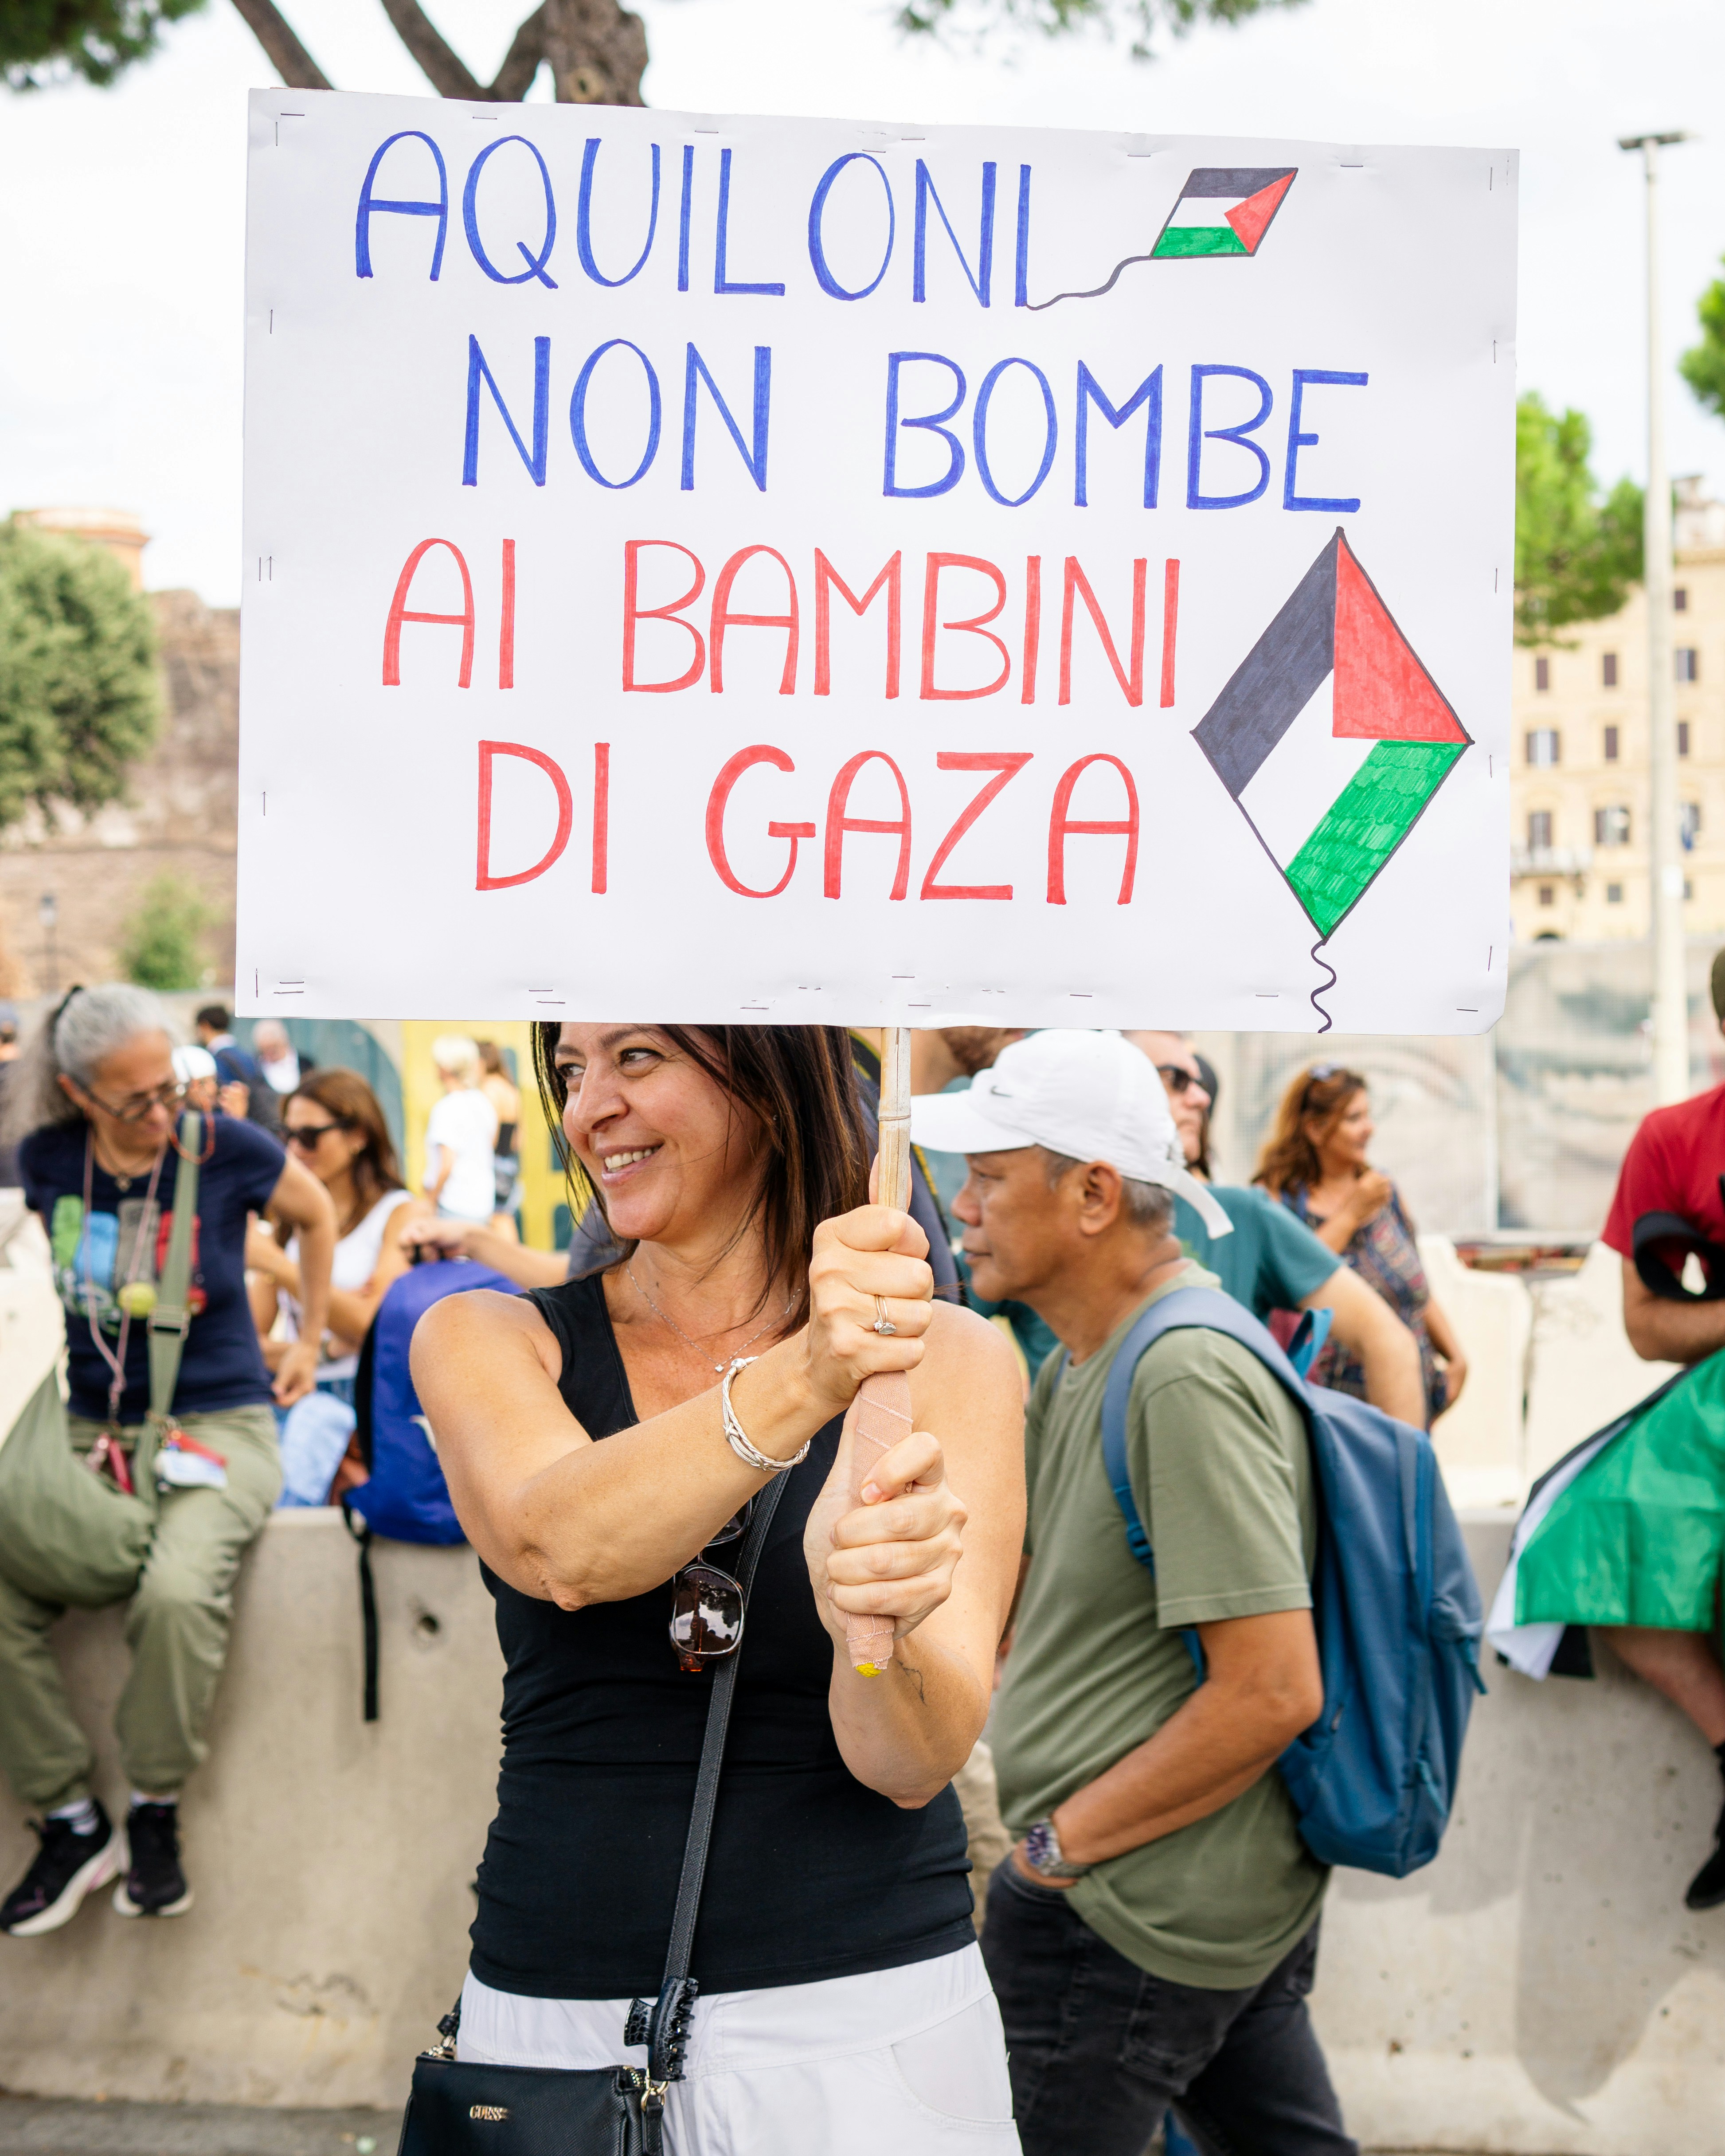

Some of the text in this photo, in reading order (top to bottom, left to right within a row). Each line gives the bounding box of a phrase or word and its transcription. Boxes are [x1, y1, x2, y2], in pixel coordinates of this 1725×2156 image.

[356, 131, 1031, 308] AQUILONI
[462, 334, 1369, 512] NON BOMBE
[383, 539, 1180, 707] AI BAMBINI
[476, 740, 1139, 905] DI GAZA
[470, 2105, 504, 2121] GUESS
